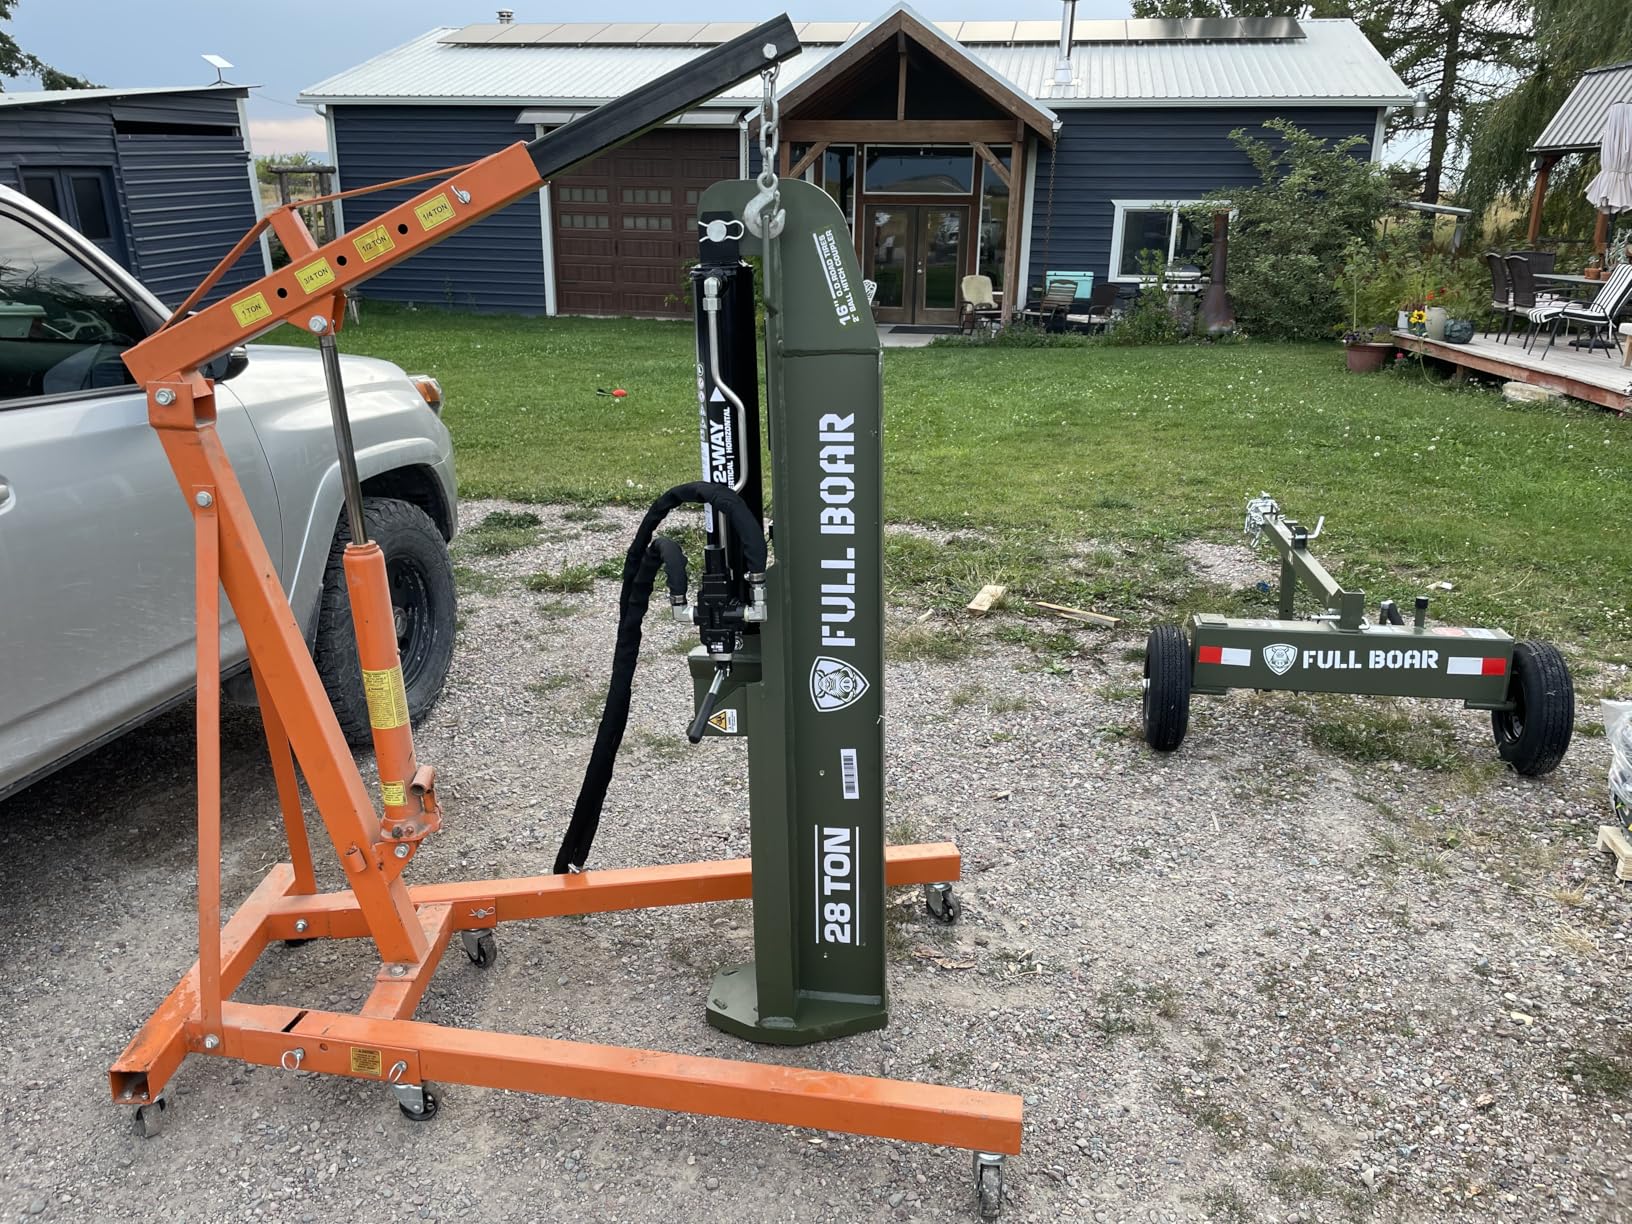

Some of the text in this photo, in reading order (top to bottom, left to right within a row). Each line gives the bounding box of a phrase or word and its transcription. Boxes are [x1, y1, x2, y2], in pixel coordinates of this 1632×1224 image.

[422, 203, 448, 221] 1/4 TON
[362, 236, 387, 252] 1/2 TON
[818, 234, 831, 259] TIRES
[826, 230, 841, 266] COUPLER
[303, 267, 329, 285] 3/4 TON
[836, 267, 851, 293] HITCH
[246, 303, 262, 314] TON
[845, 292, 857, 313] BALL
[709, 419, 728, 484] 2-WAY
[723, 407, 735, 488] ERTICAL HORIZONTAL
[818, 412, 856, 647] FULL BOAR
[1302, 649, 1439, 670] FULL BOAR
[823, 827, 851, 944] 28 TON
